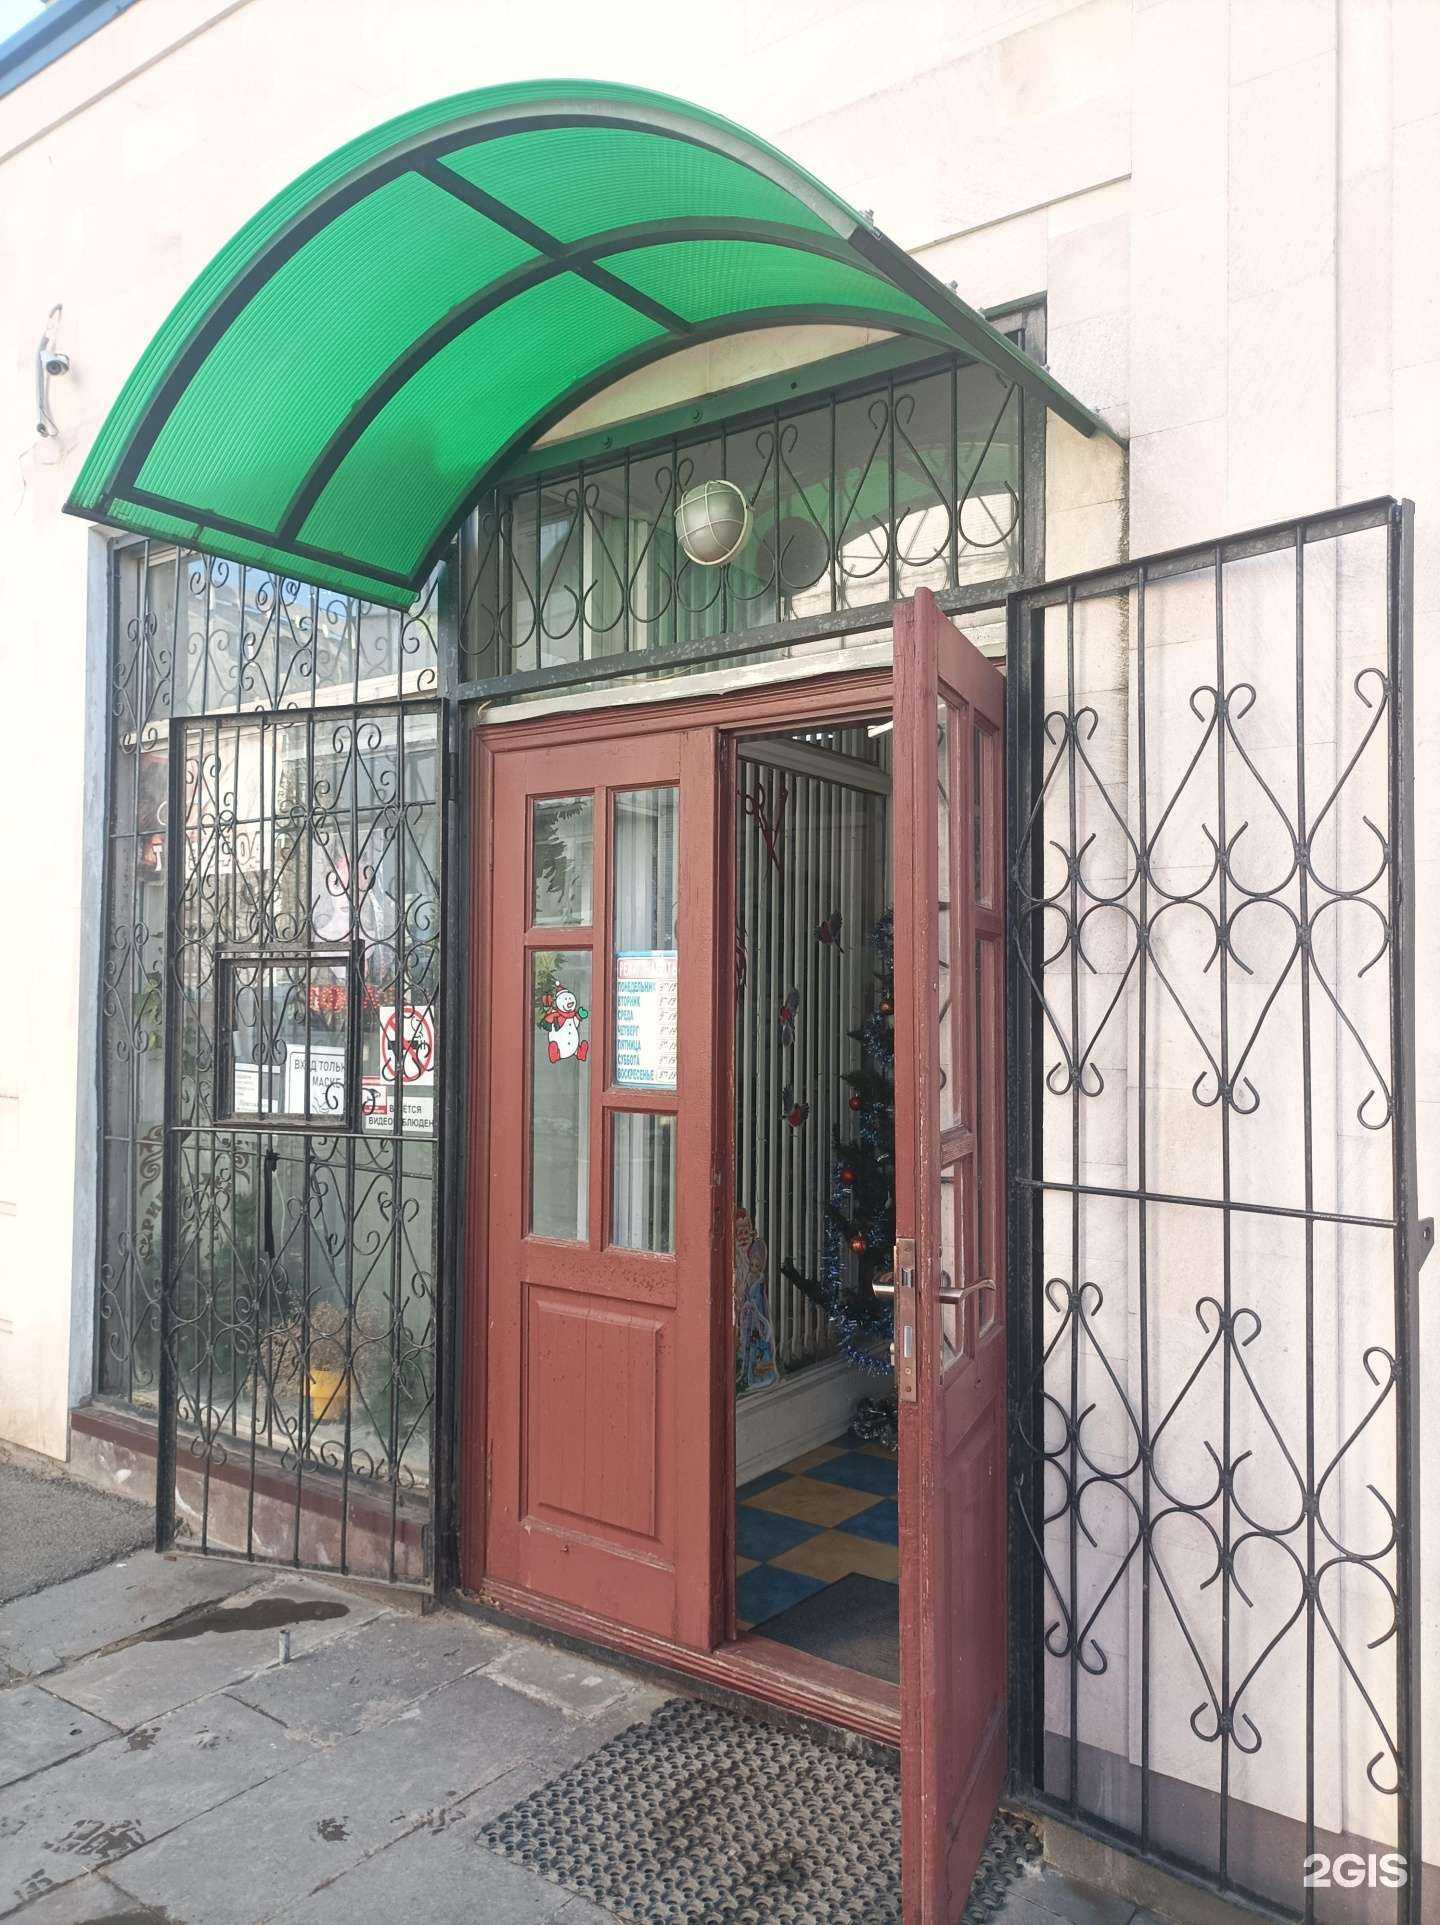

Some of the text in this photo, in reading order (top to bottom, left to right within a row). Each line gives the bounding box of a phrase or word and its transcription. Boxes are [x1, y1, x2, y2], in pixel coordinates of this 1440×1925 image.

[618, 995, 640, 1007] ВТОРНИК
[617, 1009, 633, 1021] СРЕДА
[617, 1024, 639, 1036] ЧЕТВЕРГ
[617, 1038, 641, 1052] ПЯТНИЦА
[294, 1059, 345, 1073] ВХД ТОЛЬК
[617, 1053, 640, 1066] СУББОТА
[617, 1067, 654, 1081] ВОСКРЕСЕНЬЕ
[312, 1075, 341, 1089] МАСКЕ
[389, 1104, 422, 1115] ВЕТСЯ
[368, 1116, 434, 1129] ВИДЕОБЛЮДЕН
